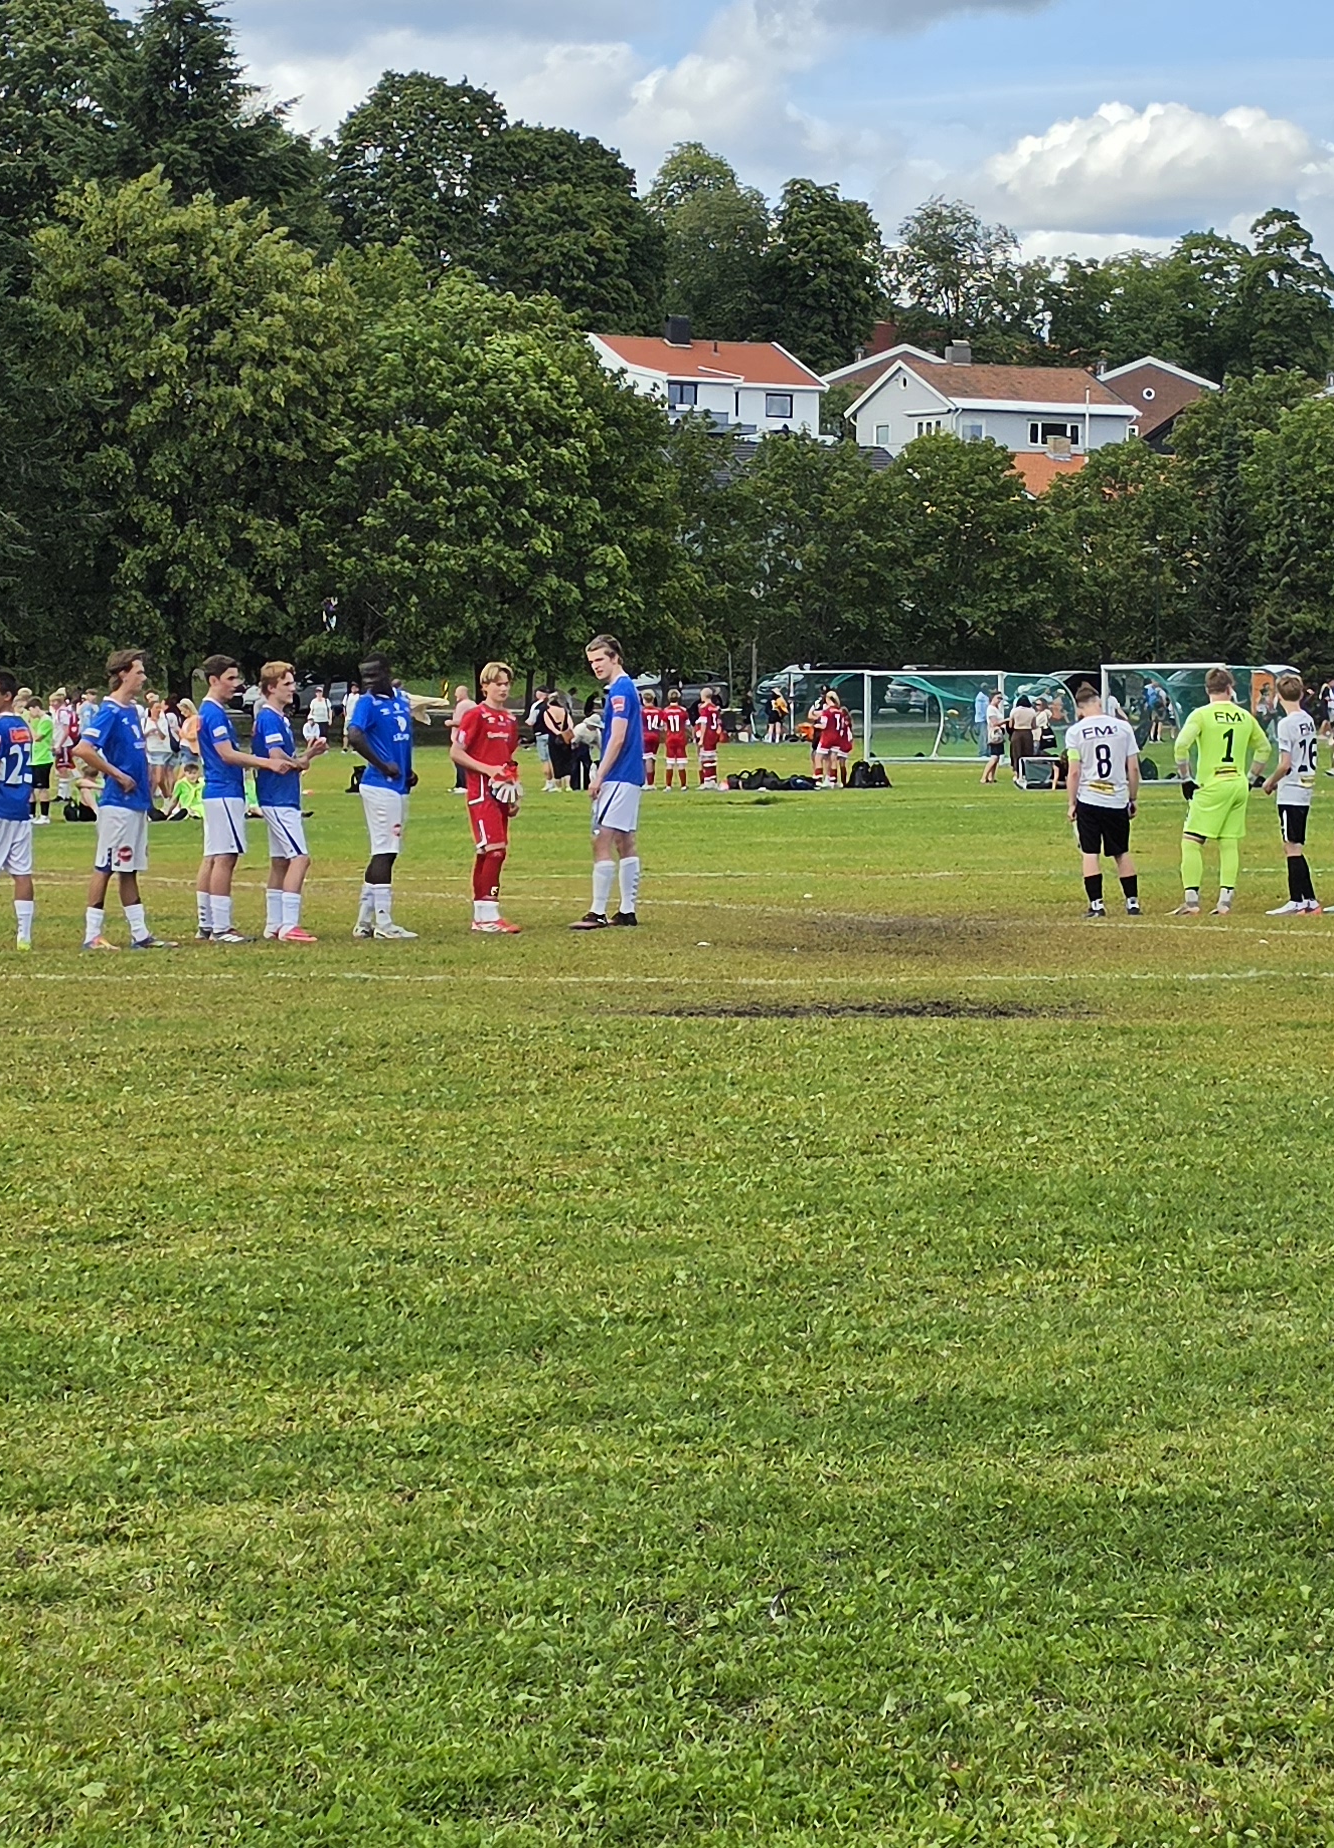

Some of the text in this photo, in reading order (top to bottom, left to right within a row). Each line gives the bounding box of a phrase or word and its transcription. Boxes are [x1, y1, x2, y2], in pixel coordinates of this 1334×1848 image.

[647, 714, 659, 731] 14
[668, 714, 680, 732] 11
[1095, 744, 1112, 778] 8
[1221, 728, 1234, 762] 1
[1298, 738, 1317, 772] 16
